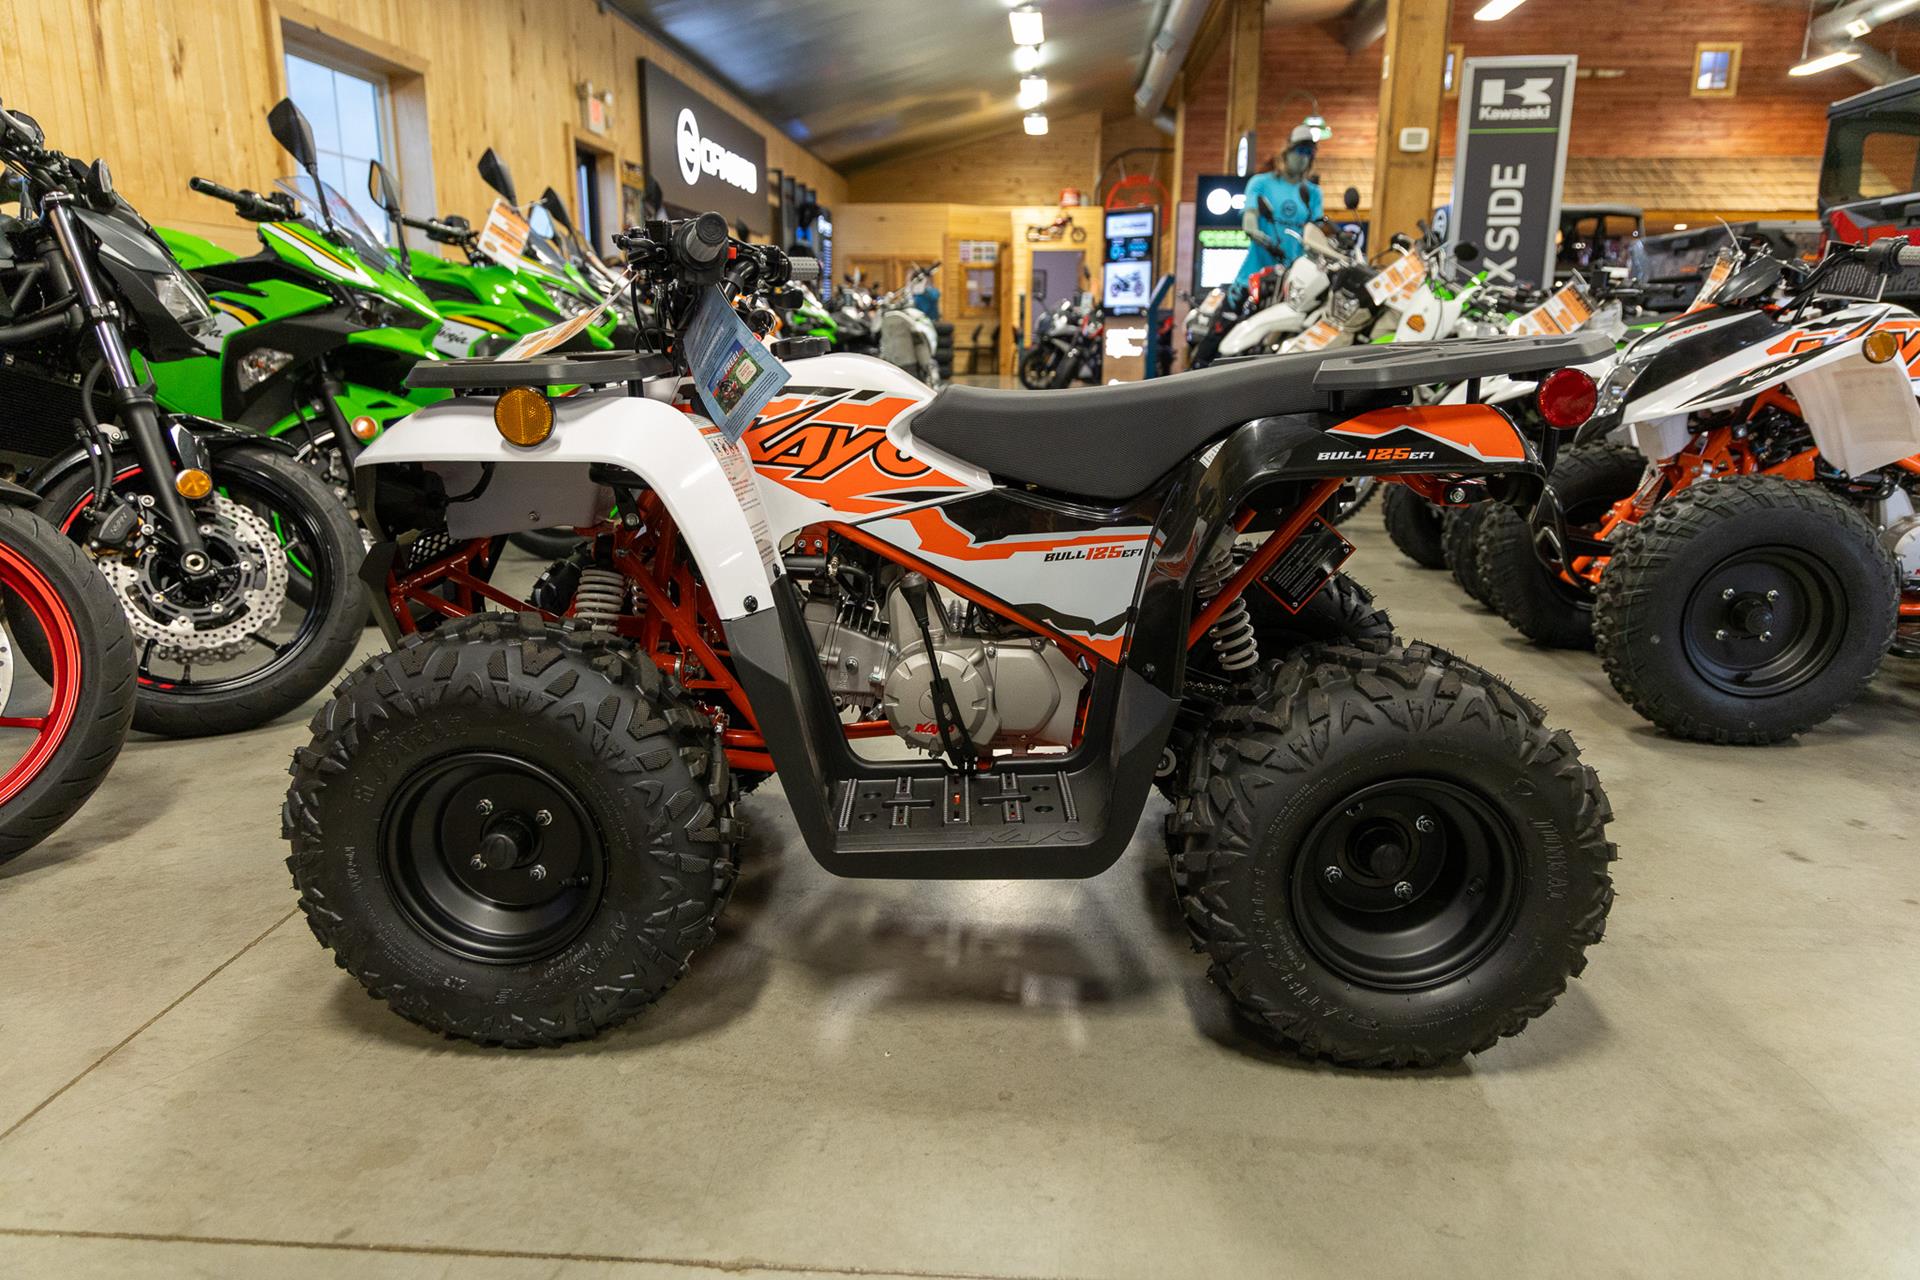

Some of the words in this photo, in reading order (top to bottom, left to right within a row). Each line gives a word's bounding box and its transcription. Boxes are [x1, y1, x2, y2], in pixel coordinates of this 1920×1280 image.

[1478, 106, 1550, 121] Kawasaki
[1484, 162, 1527, 252] SIDE
[1482, 256, 1518, 283] X
